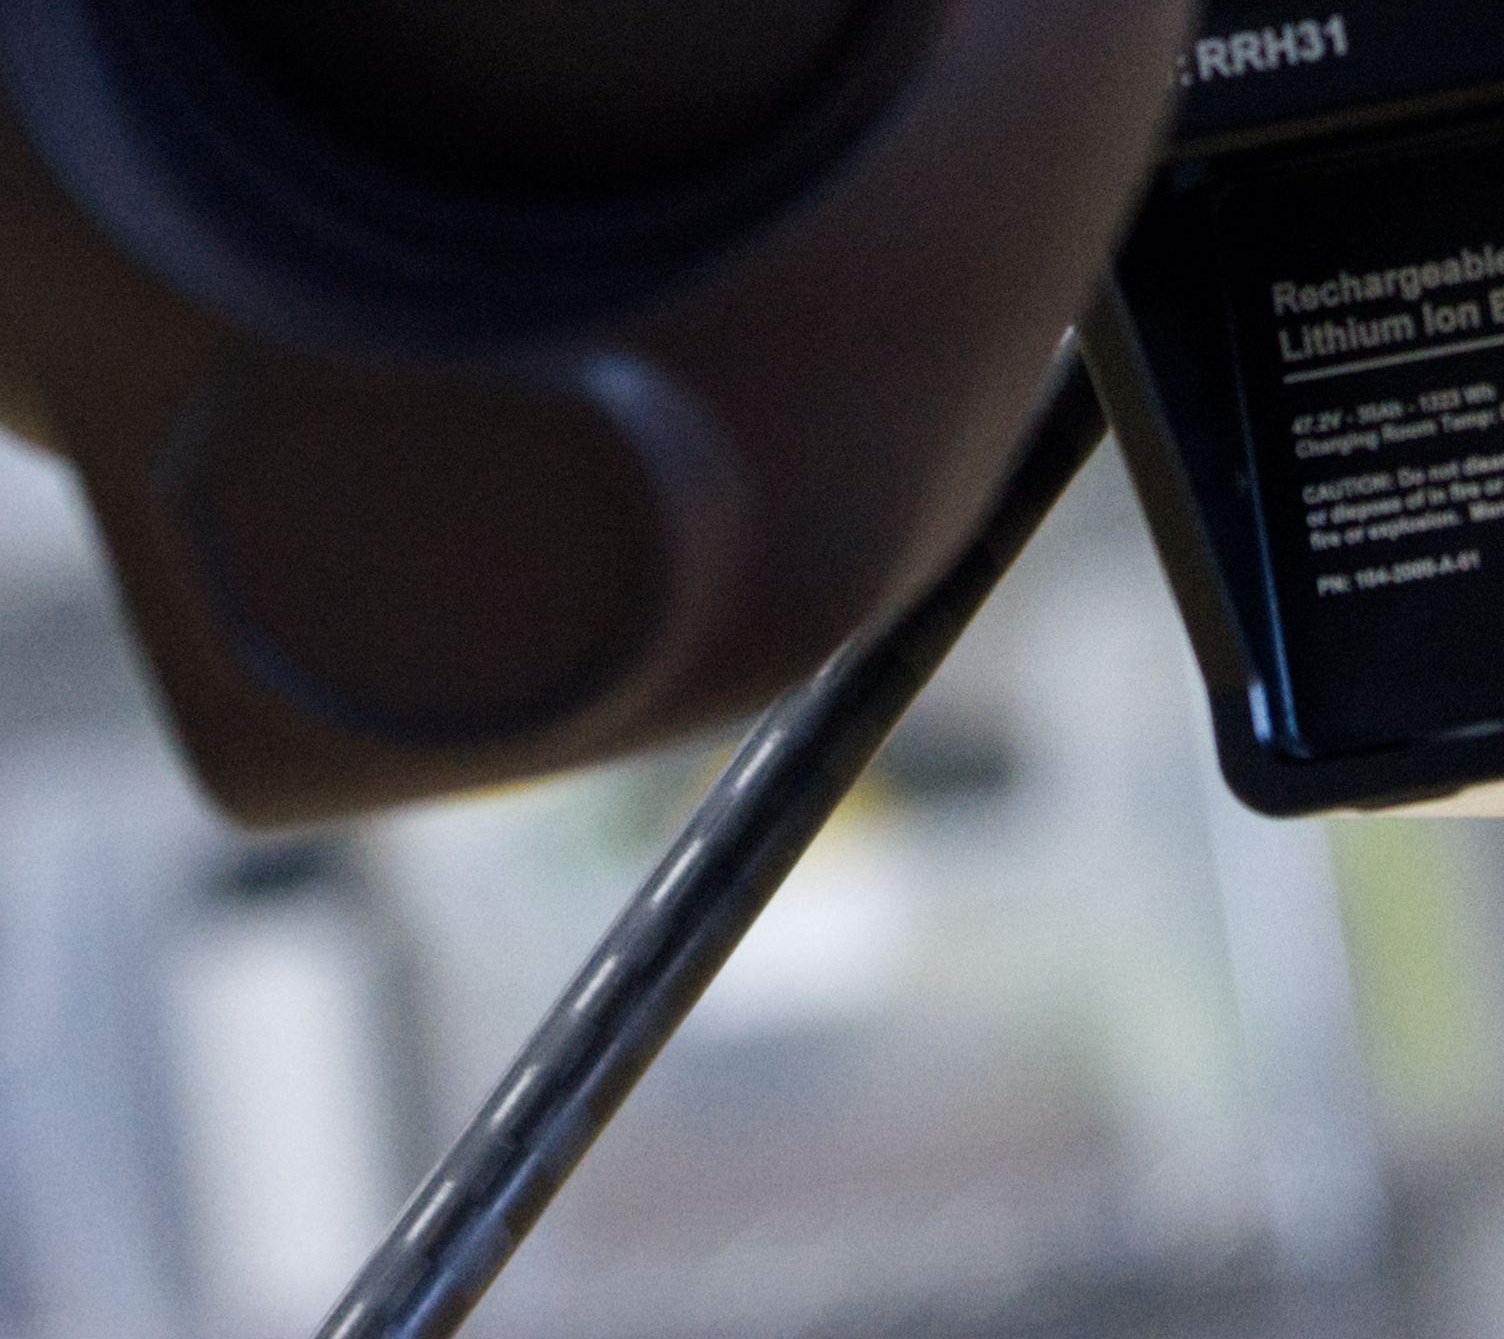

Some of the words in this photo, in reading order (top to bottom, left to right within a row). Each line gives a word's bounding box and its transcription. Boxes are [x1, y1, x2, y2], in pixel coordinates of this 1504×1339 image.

[1195, 14, 1348, 81] RRH31
[1279, 313, 1415, 362] Lithium
[1422, 297, 1481, 336] Ion
[1295, 431, 1379, 459] Charging
[1302, 472, 1394, 504] CAUTION:
[1396, 465, 1427, 489] Do
[1427, 460, 1460, 481] not
[1306, 509, 1327, 528] or
[1405, 489, 1425, 510] of
[1427, 488, 1446, 506] in
[1449, 481, 1481, 502] fire
[1483, 478, 1504, 497] or
[1309, 530, 1341, 551] fire
[1344, 527, 1365, 544] or
[1316, 574, 1353, 597] PN:
